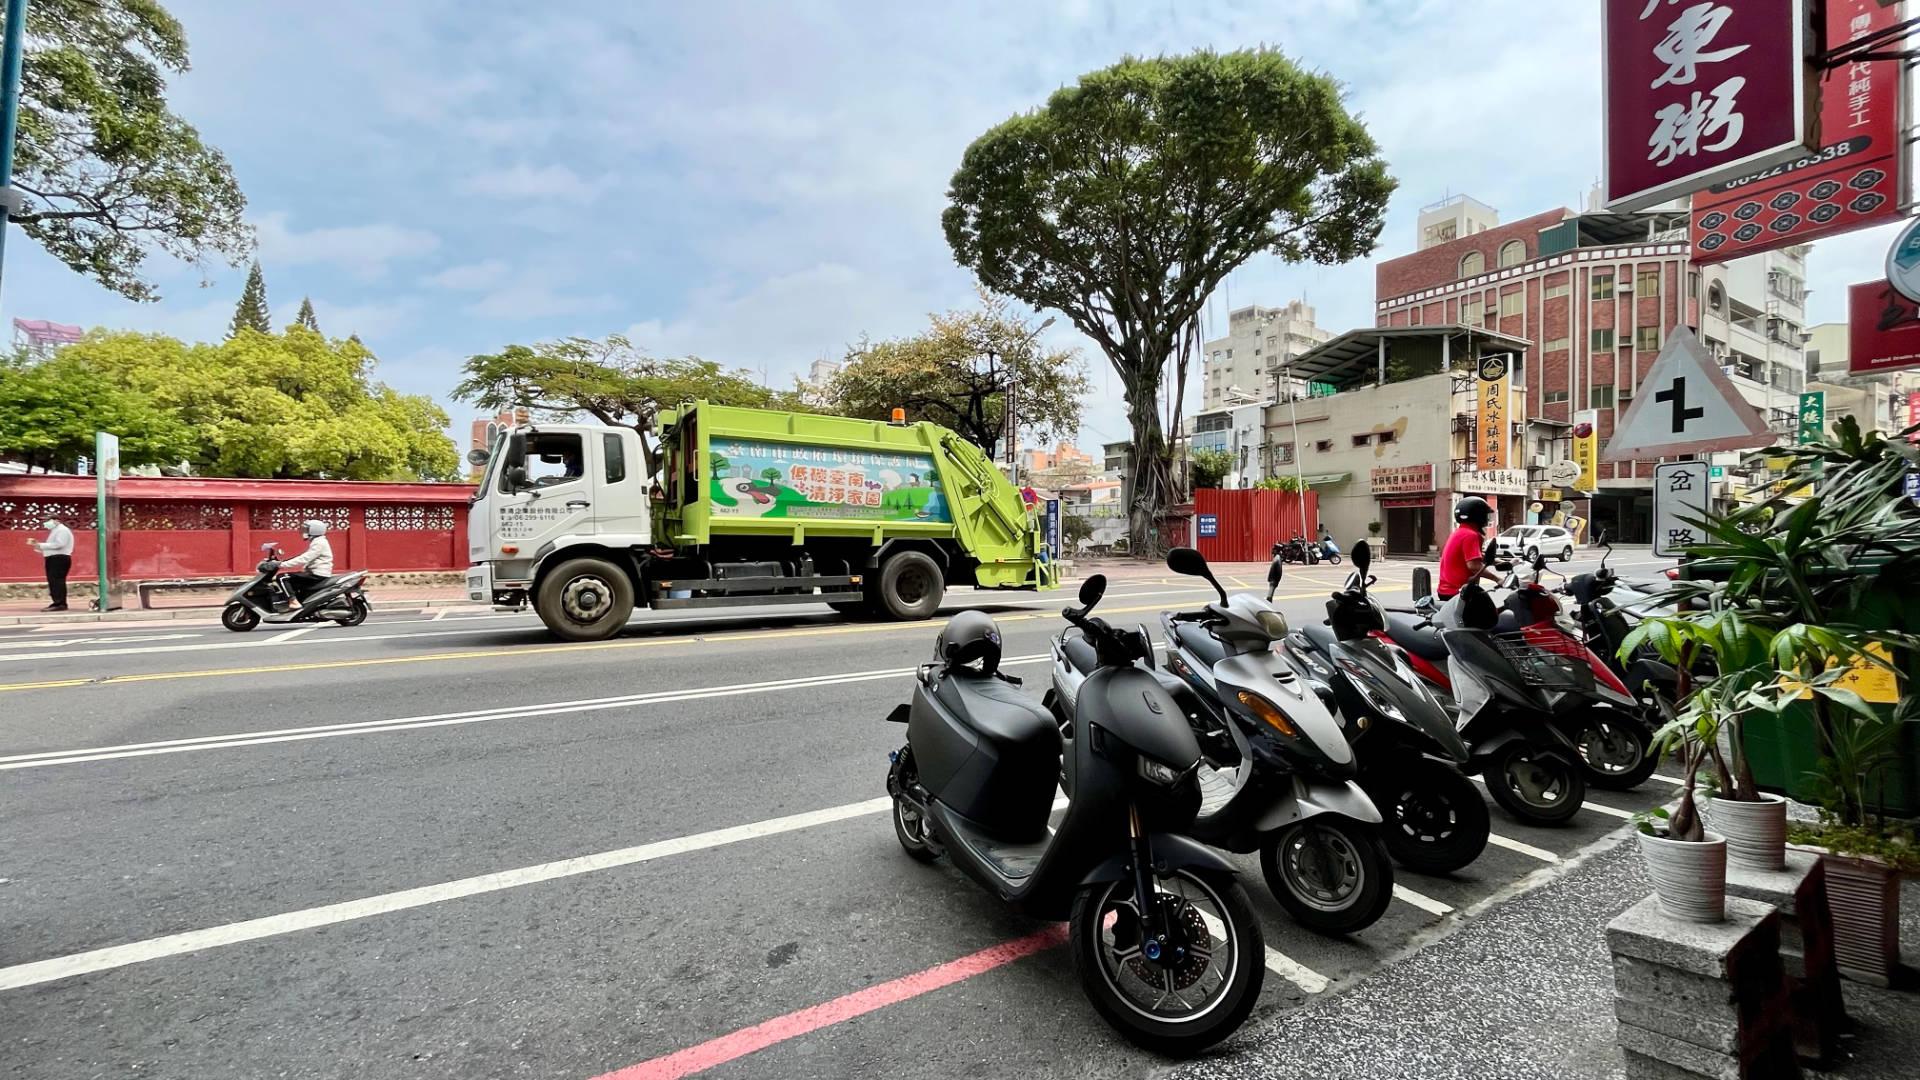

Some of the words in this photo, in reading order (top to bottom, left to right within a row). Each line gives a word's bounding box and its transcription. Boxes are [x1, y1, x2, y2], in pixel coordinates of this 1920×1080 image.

[1640, 0, 1751, 167] 東粥
[1848, 13, 1872, 128] 傳代純手工
[1486, 384, 1502, 467] 周氏冰鎮滷味
[790, 465, 865, 487] 低碳臺南
